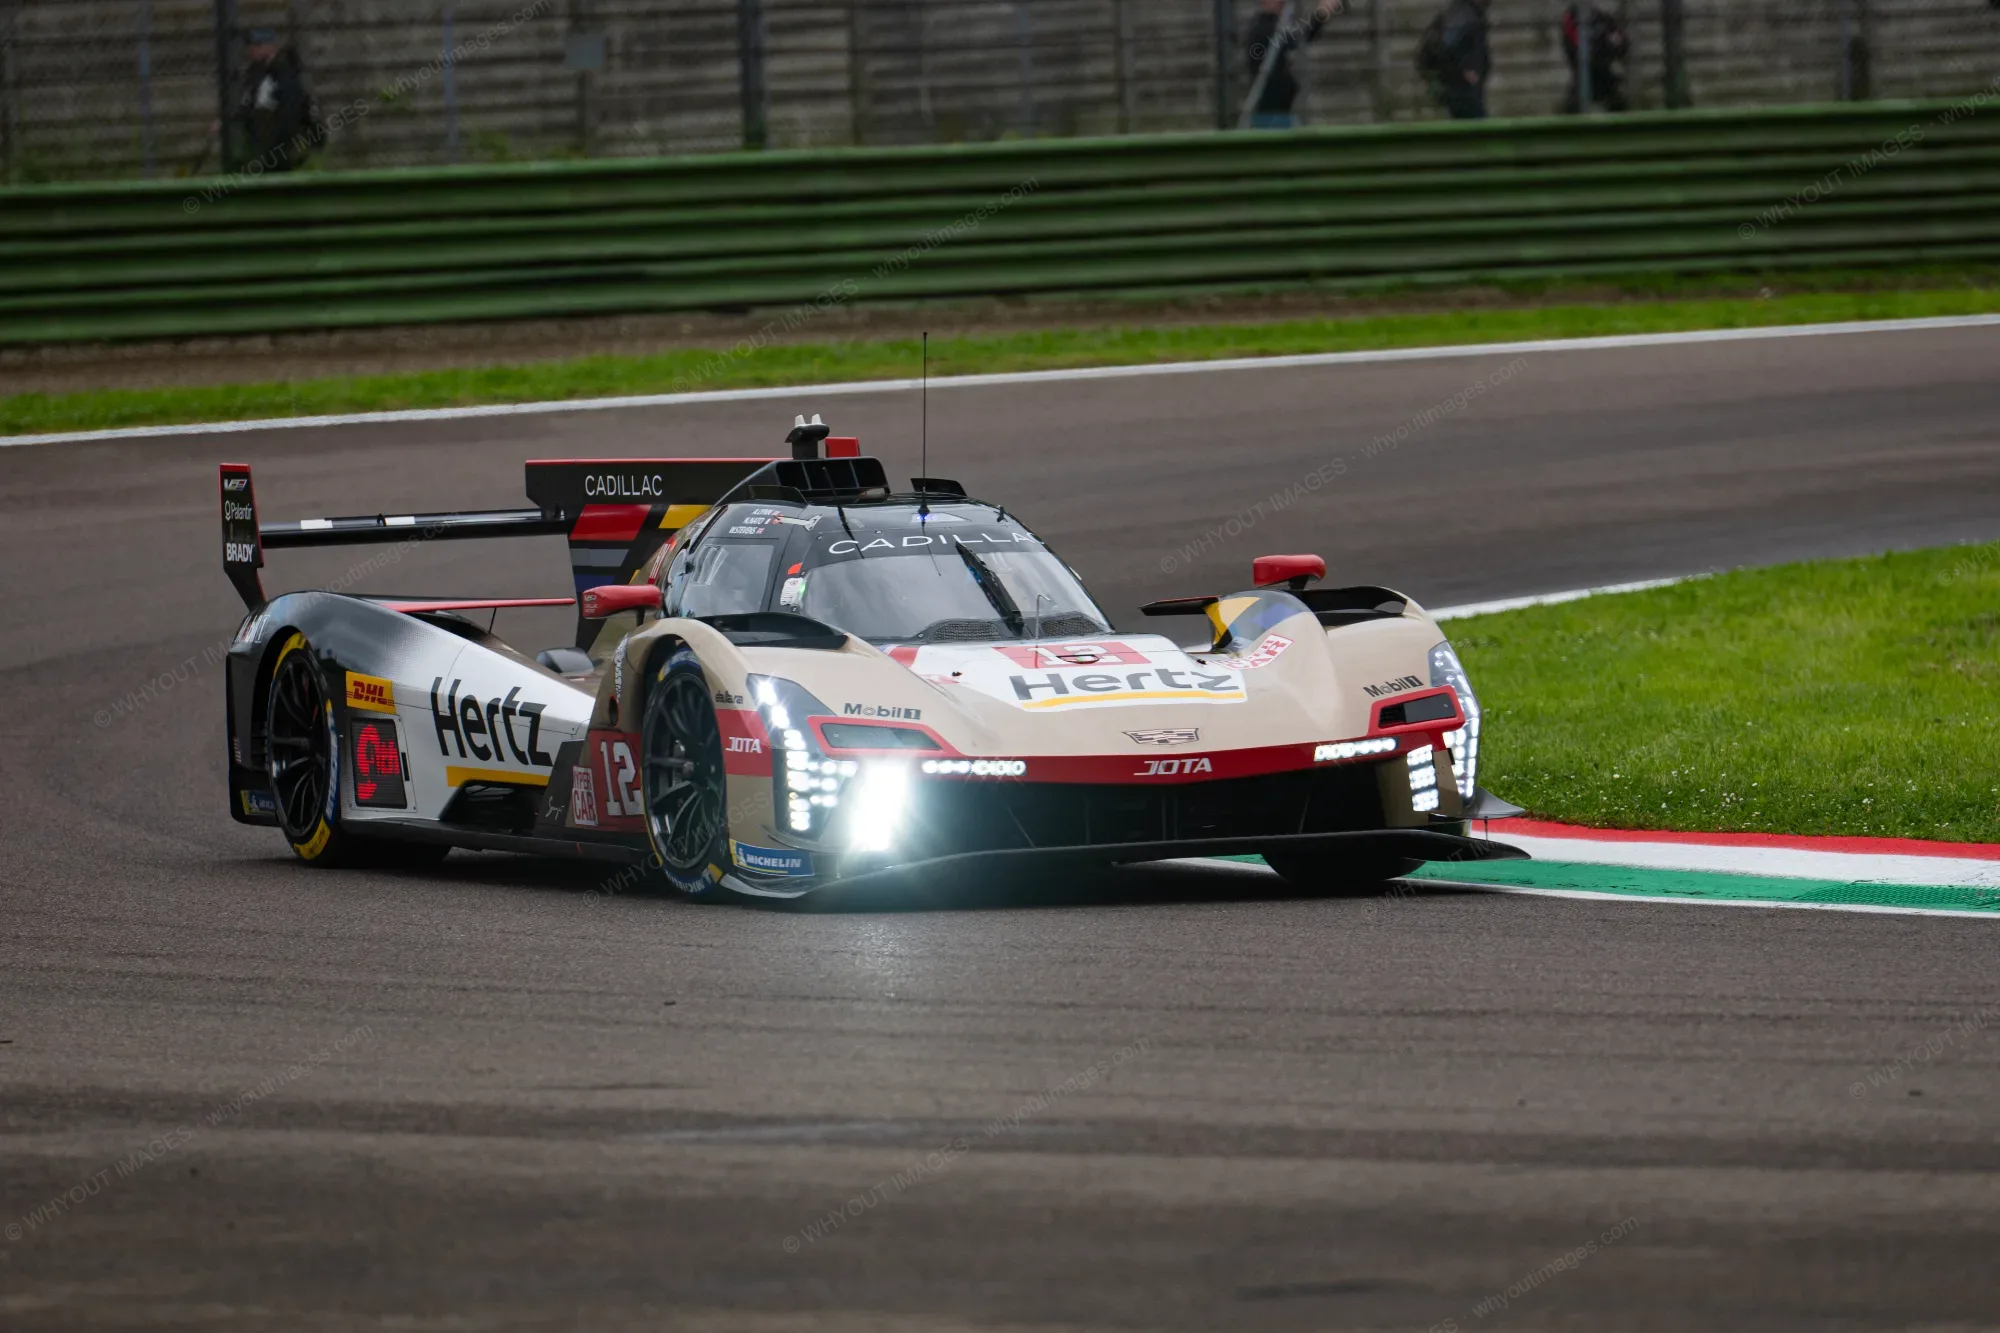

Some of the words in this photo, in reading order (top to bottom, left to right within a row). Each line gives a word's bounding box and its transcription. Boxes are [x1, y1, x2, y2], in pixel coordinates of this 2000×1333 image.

[585, 474, 663, 496] CADILLAC
[231, 501, 253, 520] Palantir
[226, 543, 254, 563] BRADY
[353, 680, 388, 705] DHL
[1008, 668, 1240, 700] Hertz
[1362, 677, 1411, 698] Mobil
[844, 702, 902, 718] Mobil
[431, 676, 554, 767] Hertz
[725, 736, 763, 754] JOTA
[1133, 757, 1213, 776] JOTA
[600, 741, 645, 816] 12
[574, 790, 597, 822] CAR
[746, 853, 802, 868] MICHELIN
